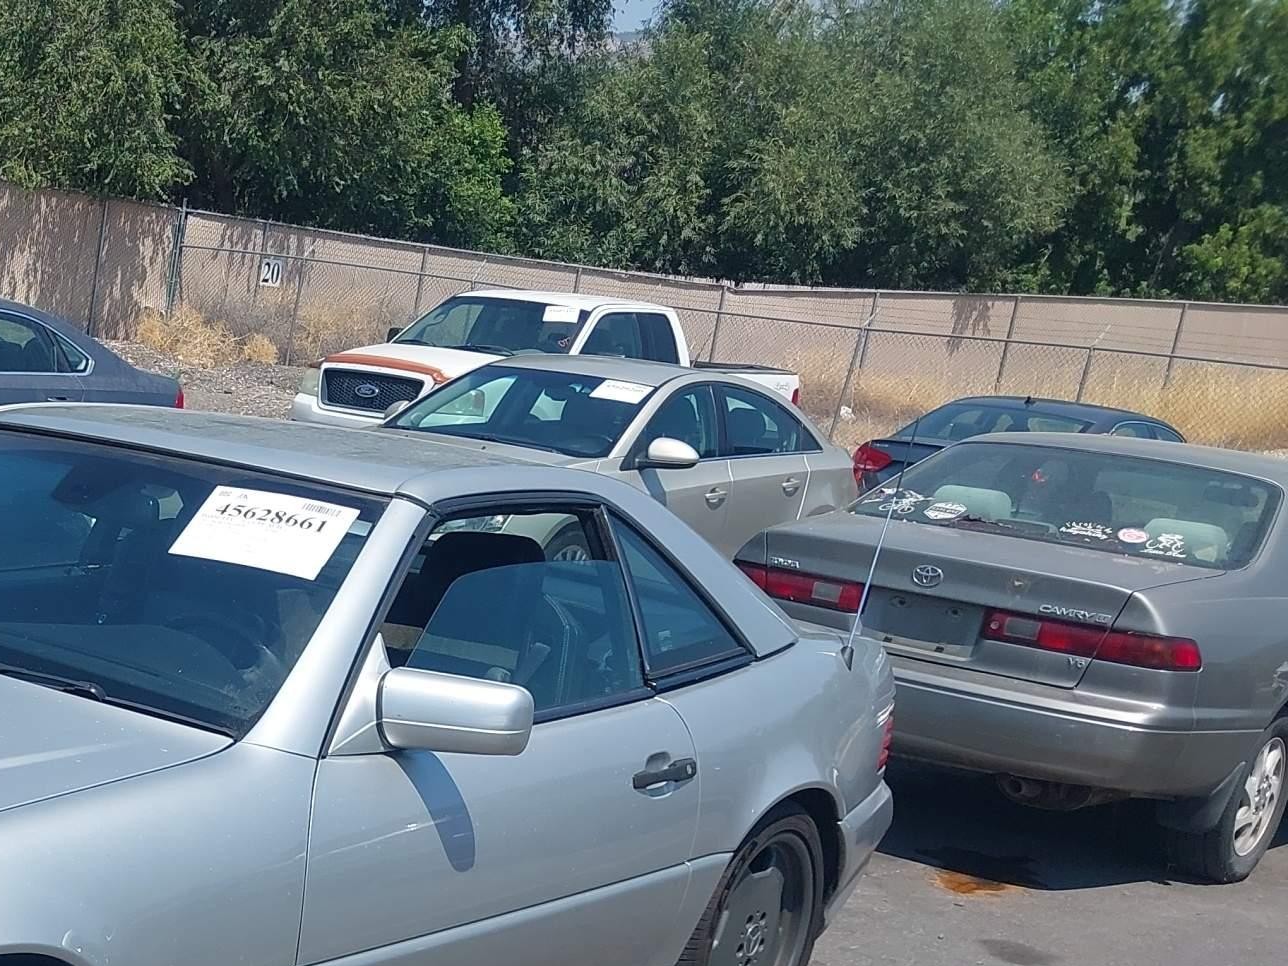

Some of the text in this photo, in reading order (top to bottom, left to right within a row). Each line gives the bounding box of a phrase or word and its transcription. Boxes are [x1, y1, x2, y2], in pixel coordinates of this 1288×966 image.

[262, 262, 280, 284] 20
[215, 503, 328, 533] 45628661
[1039, 604, 1096, 619] CAMRY
[1067, 657, 1085, 668] V6
